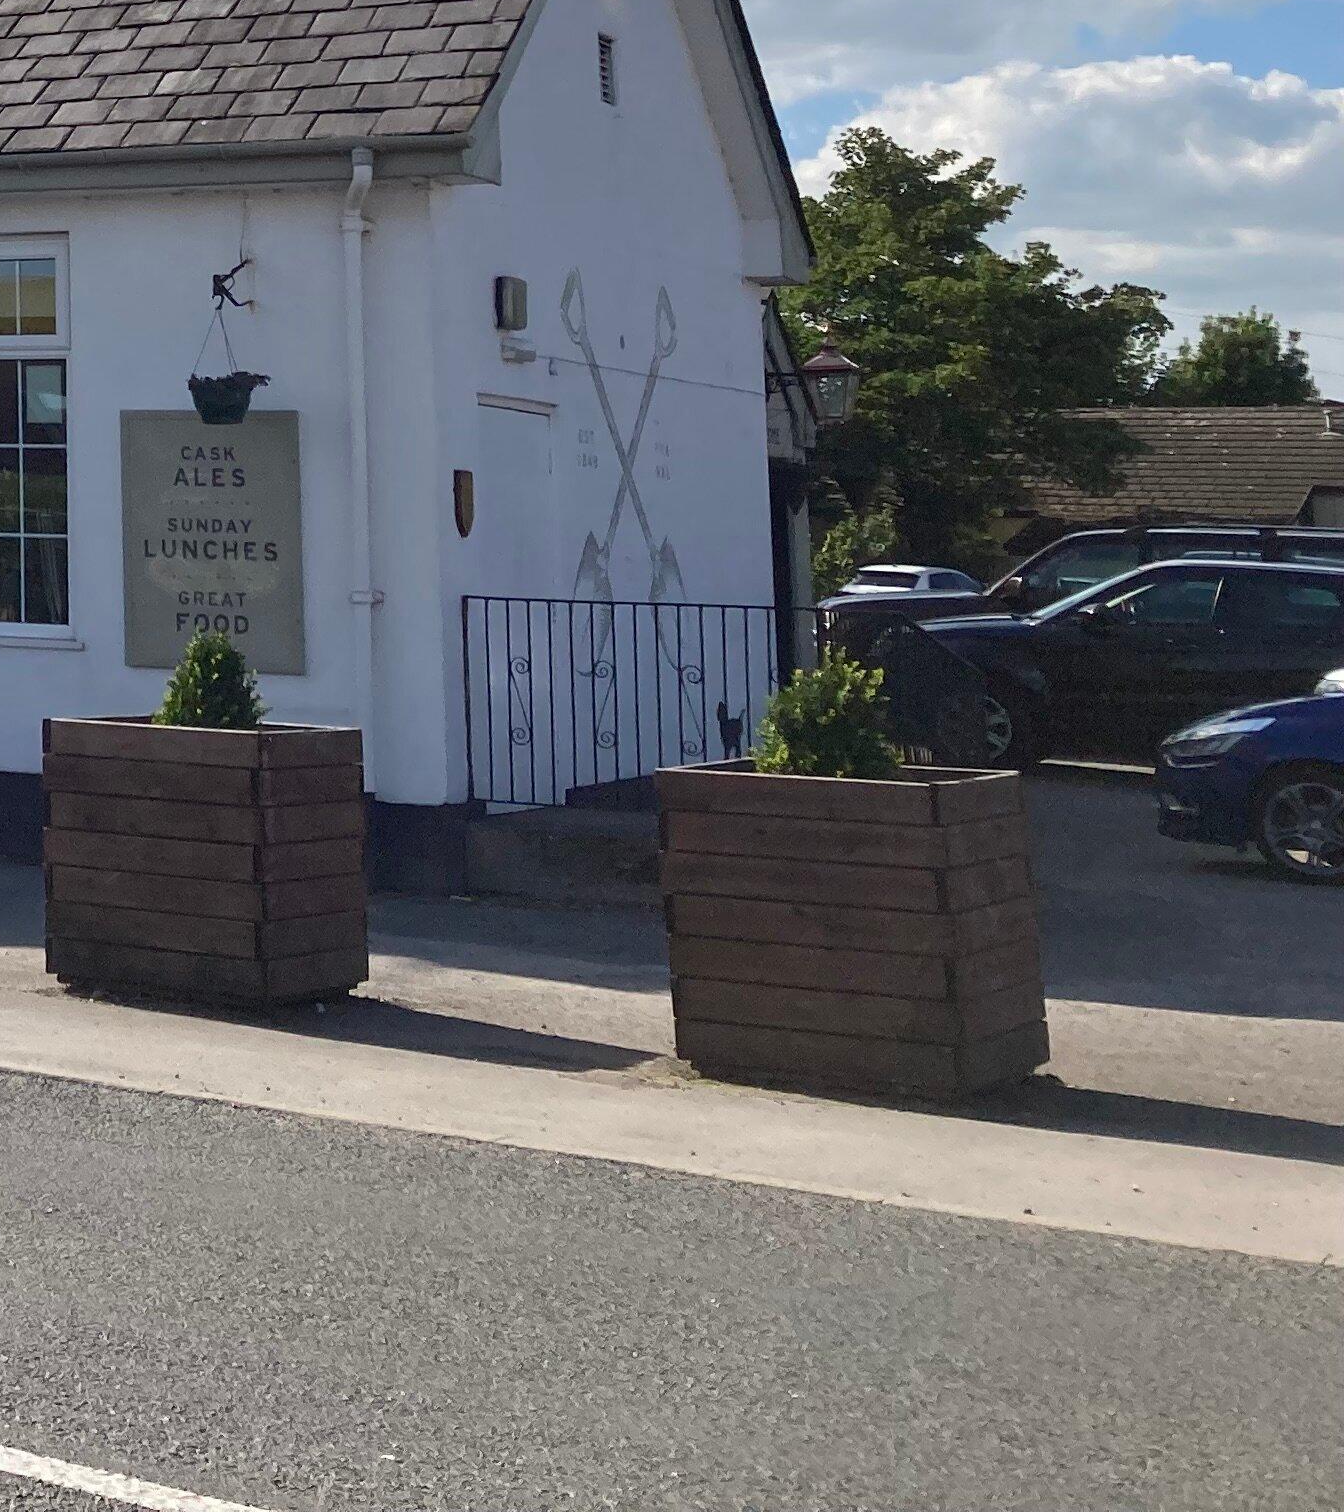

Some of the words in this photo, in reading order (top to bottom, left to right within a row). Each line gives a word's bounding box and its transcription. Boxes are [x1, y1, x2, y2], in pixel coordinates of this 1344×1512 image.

[180, 445, 236, 461] CASK
[173, 467, 246, 488] ALES
[167, 517, 253, 535] SUNDAY
[143, 539, 279, 562] LUNCHES
[178, 590, 247, 608] GREAT
[175, 612, 250, 635] FOOD
